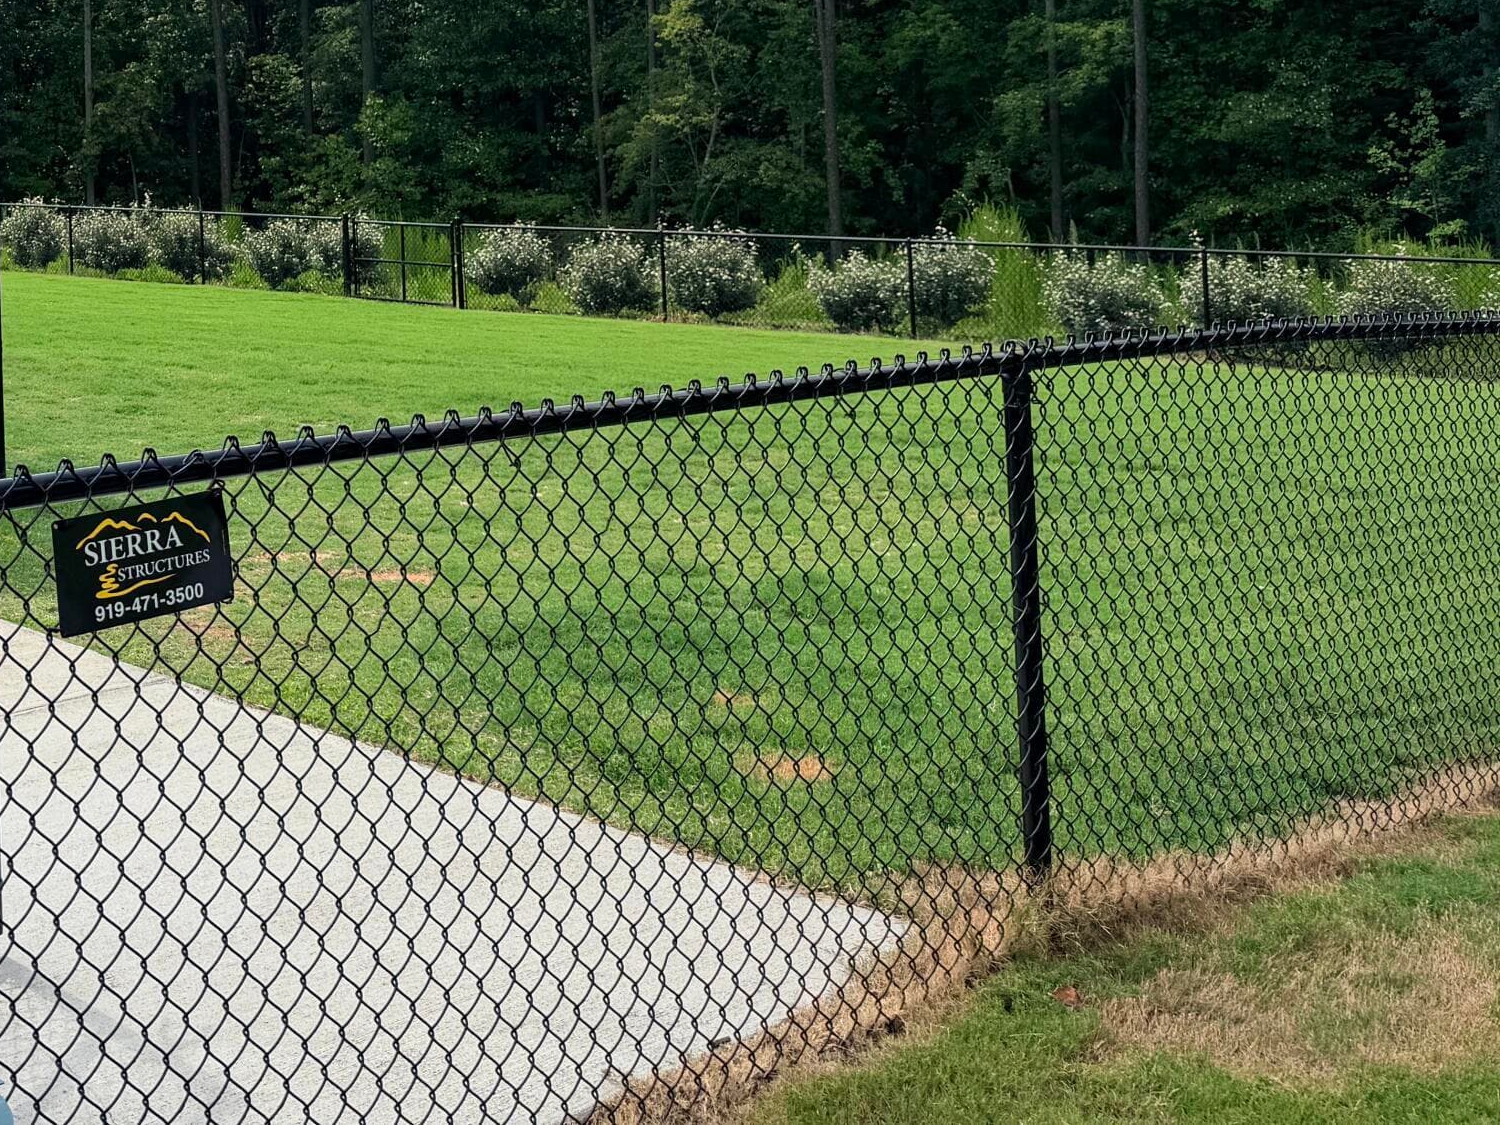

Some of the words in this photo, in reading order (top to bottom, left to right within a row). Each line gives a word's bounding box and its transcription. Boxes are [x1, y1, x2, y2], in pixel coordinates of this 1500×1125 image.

[84, 525, 184, 567] SIERRA
[117, 548, 211, 582] STRUCTURES
[94, 582, 204, 623] 919-471-3500
